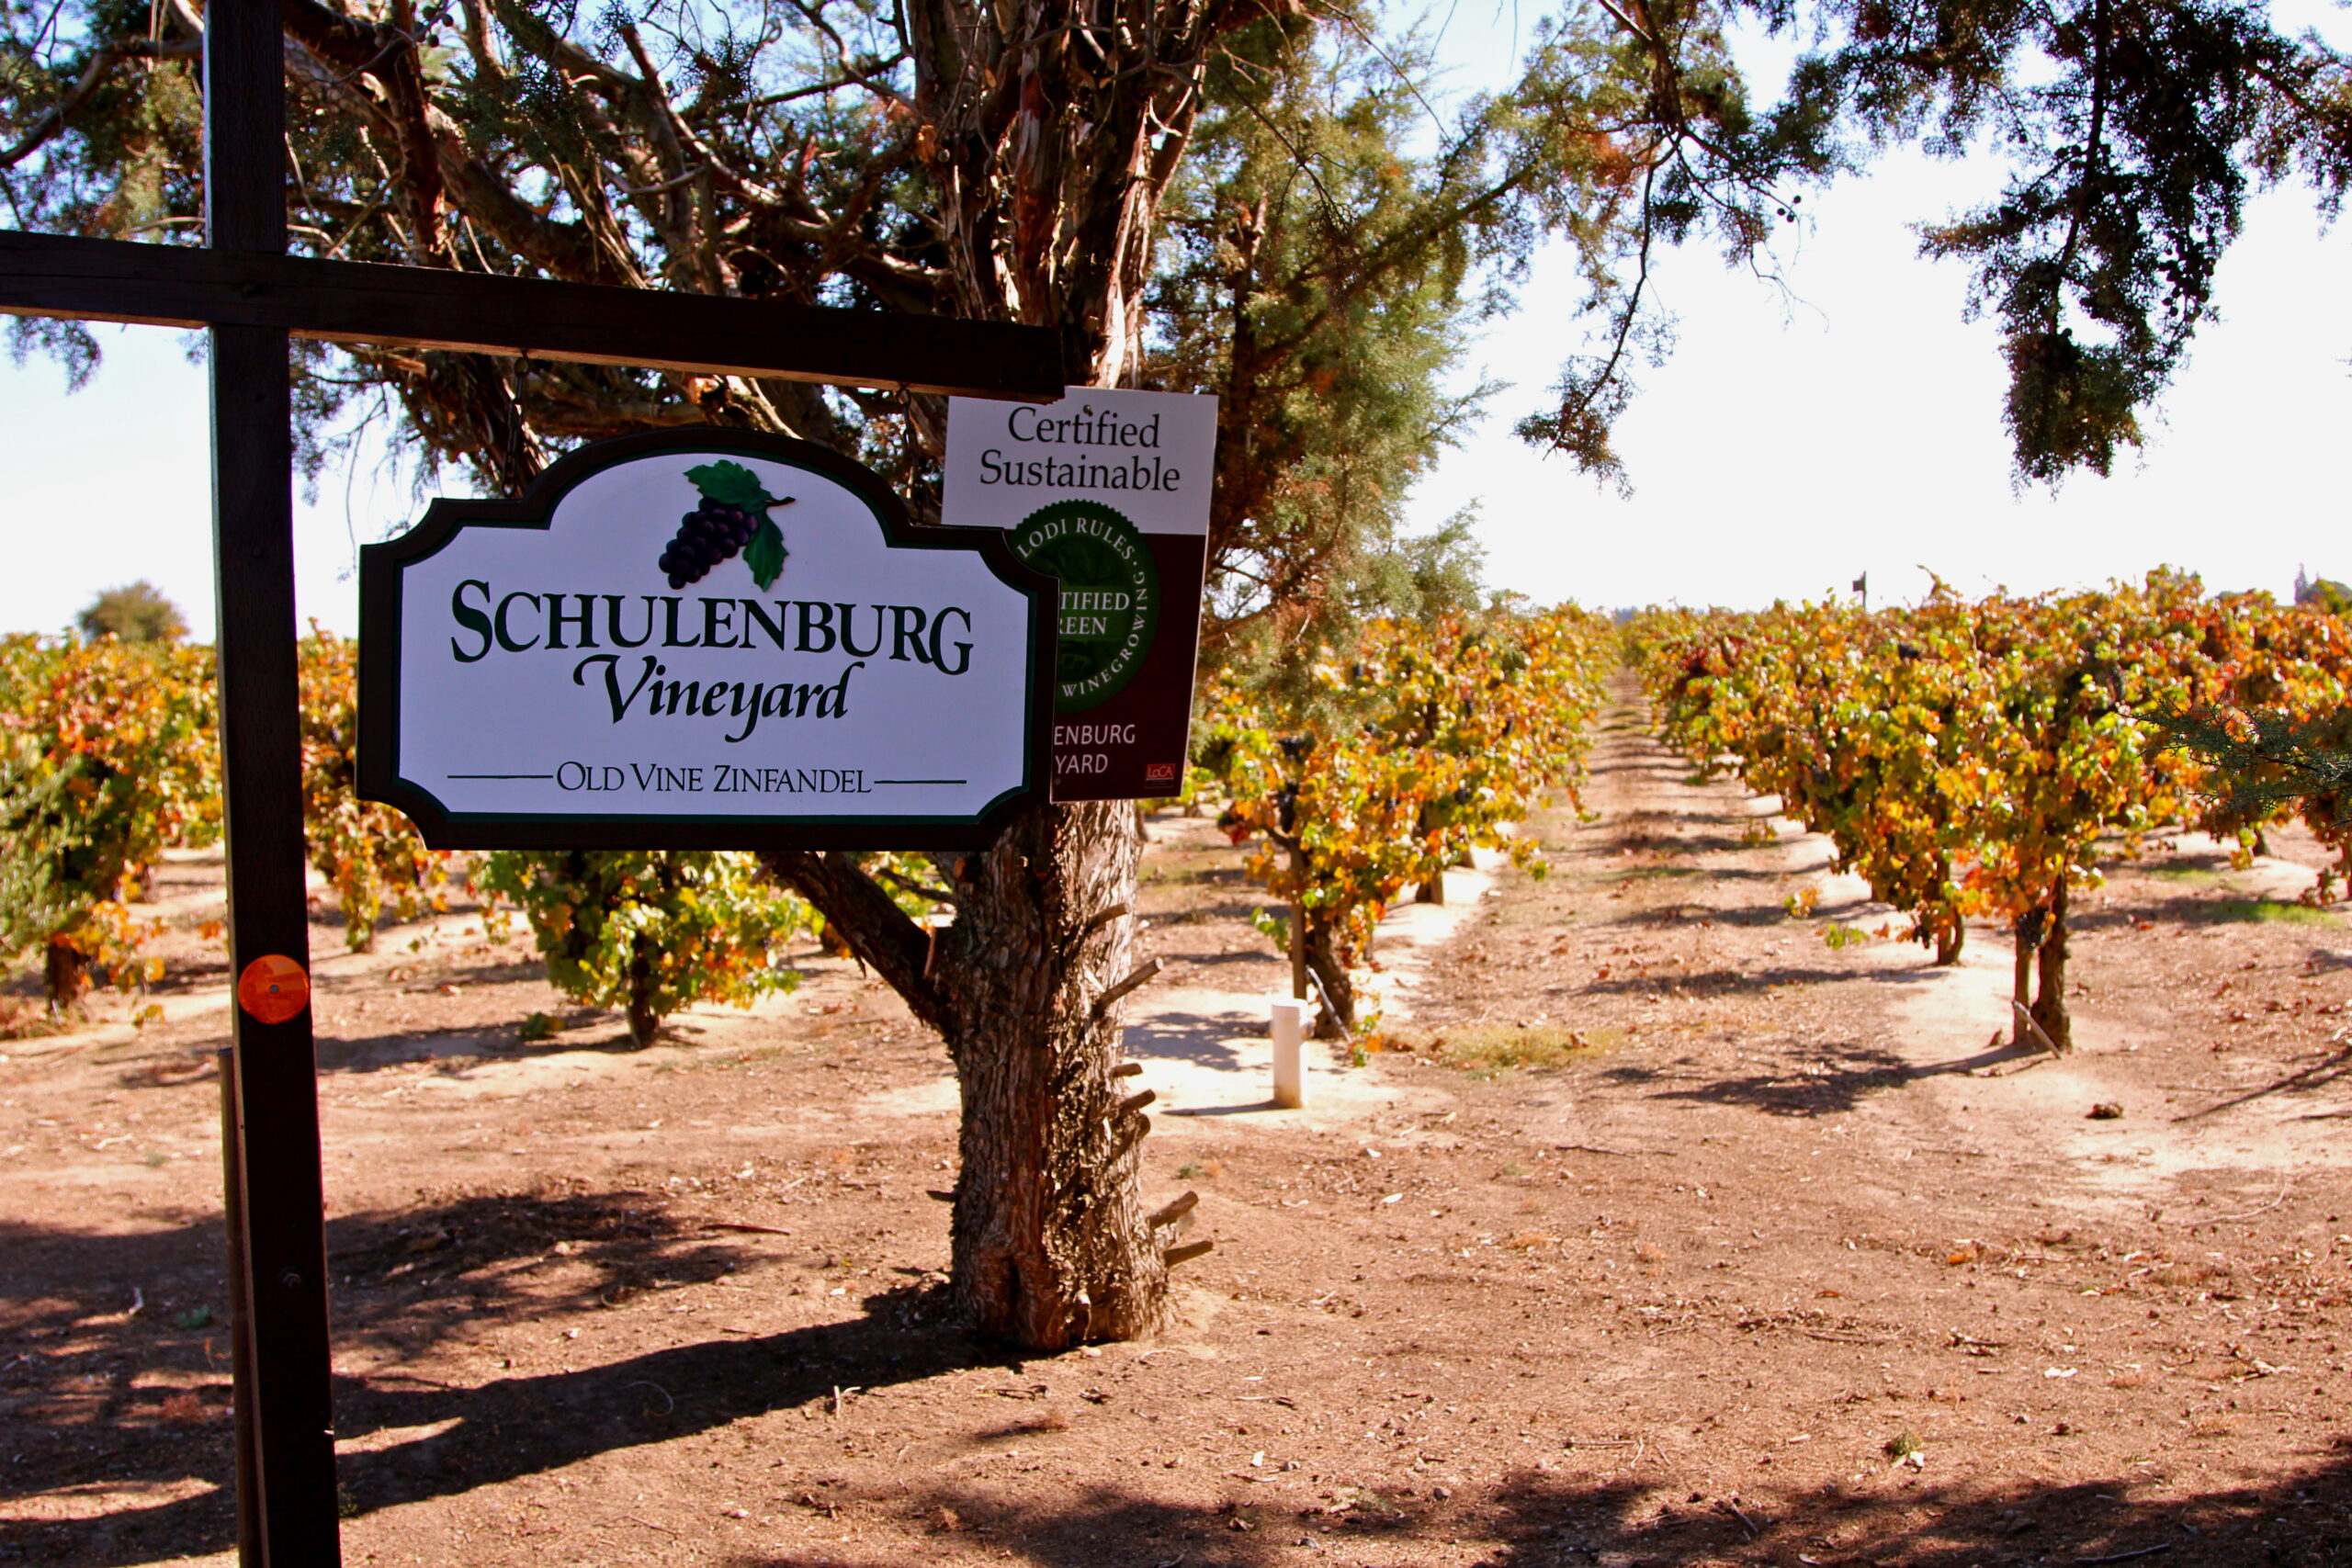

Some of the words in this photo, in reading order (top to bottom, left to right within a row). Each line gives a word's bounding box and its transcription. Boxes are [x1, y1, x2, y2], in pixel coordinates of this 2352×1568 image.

[1009, 406, 1159, 447] Certified
[980, 449, 1181, 491] Sustainable
[1017, 519, 1067, 558] LODI
[1077, 517, 1135, 559] RULES
[450, 580, 974, 675] SCHULENBURG
[1062, 571, 1148, 696] WINEGROWING
[573, 655, 865, 742] Vineyard
[1054, 724, 1136, 745] ENBURG
[557, 761, 624, 792] OLD
[630, 763, 703, 793] VINE
[713, 765, 871, 794] ZINFANDEL
[1055, 754, 1108, 773] YARD
